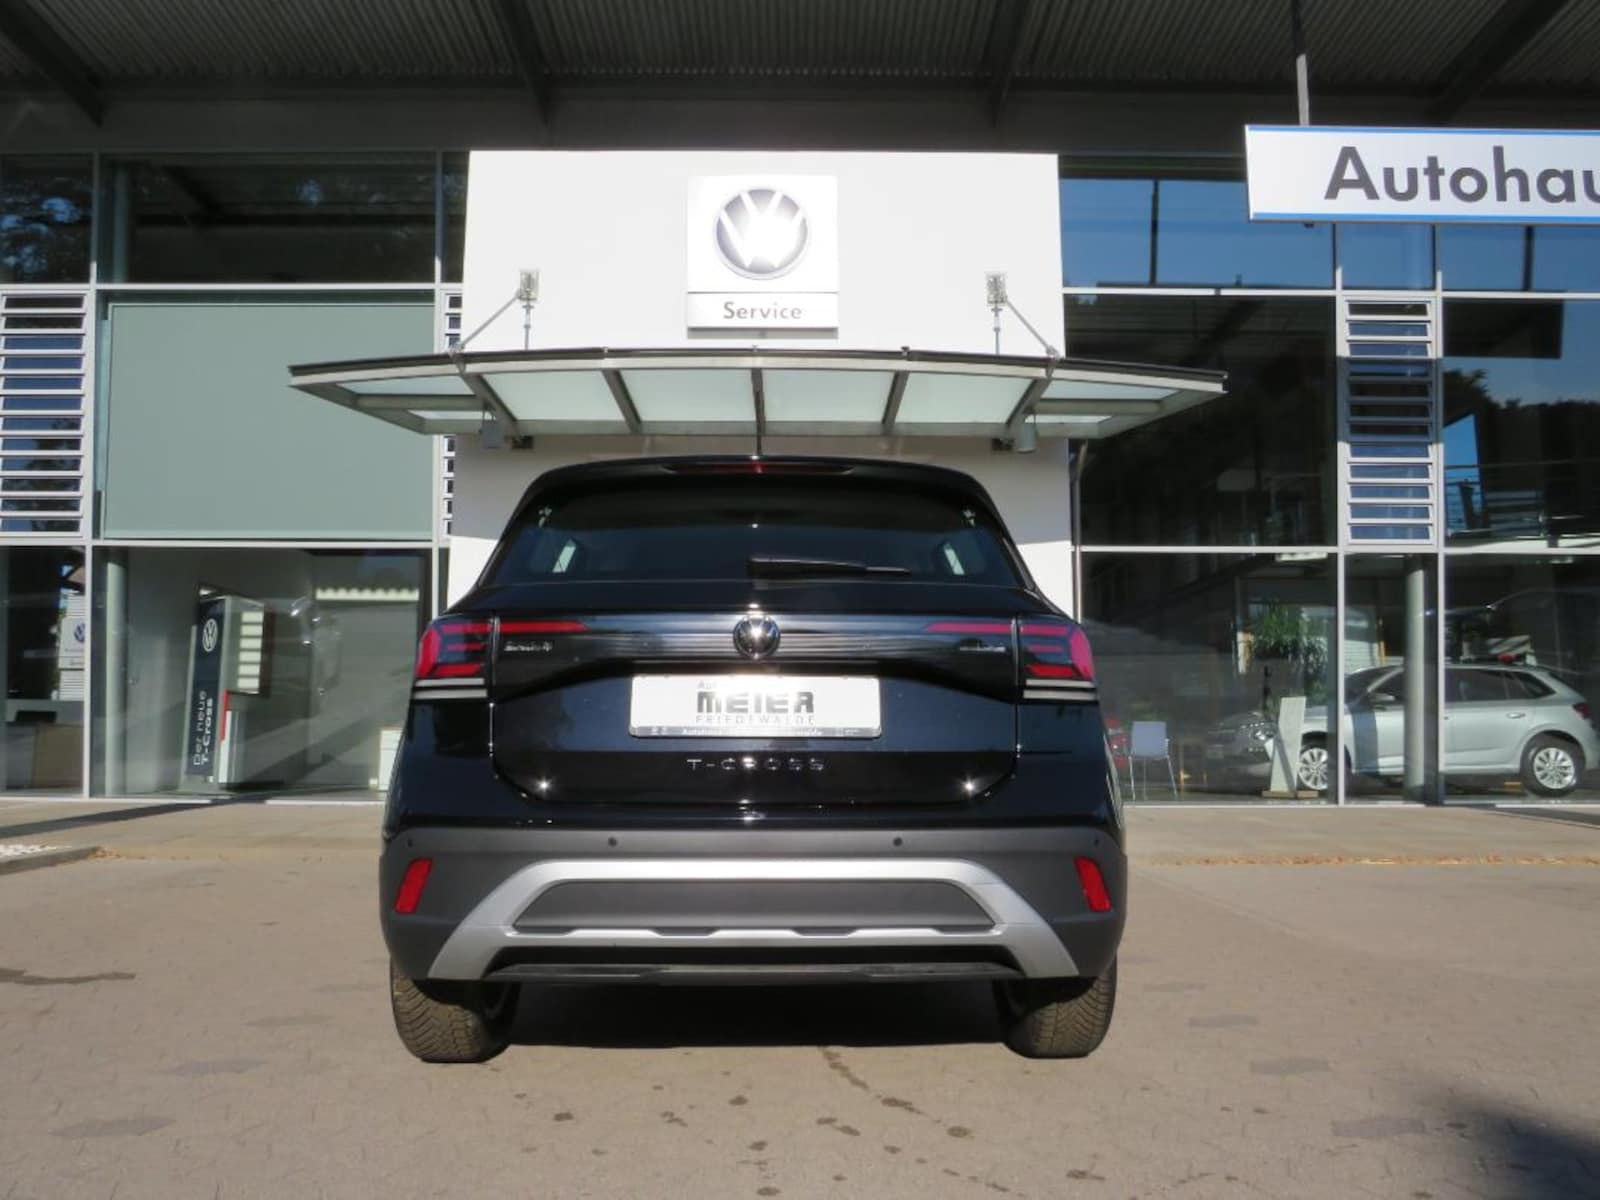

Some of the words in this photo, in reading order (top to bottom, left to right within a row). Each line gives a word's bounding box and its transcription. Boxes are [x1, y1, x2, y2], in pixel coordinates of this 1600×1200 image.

[723, 301, 802, 319] Service
[197, 690, 207, 731] neue
[697, 691, 814, 713] MEIER
[202, 698, 213, 765] T-Cross
[194, 737, 202, 765] Der
